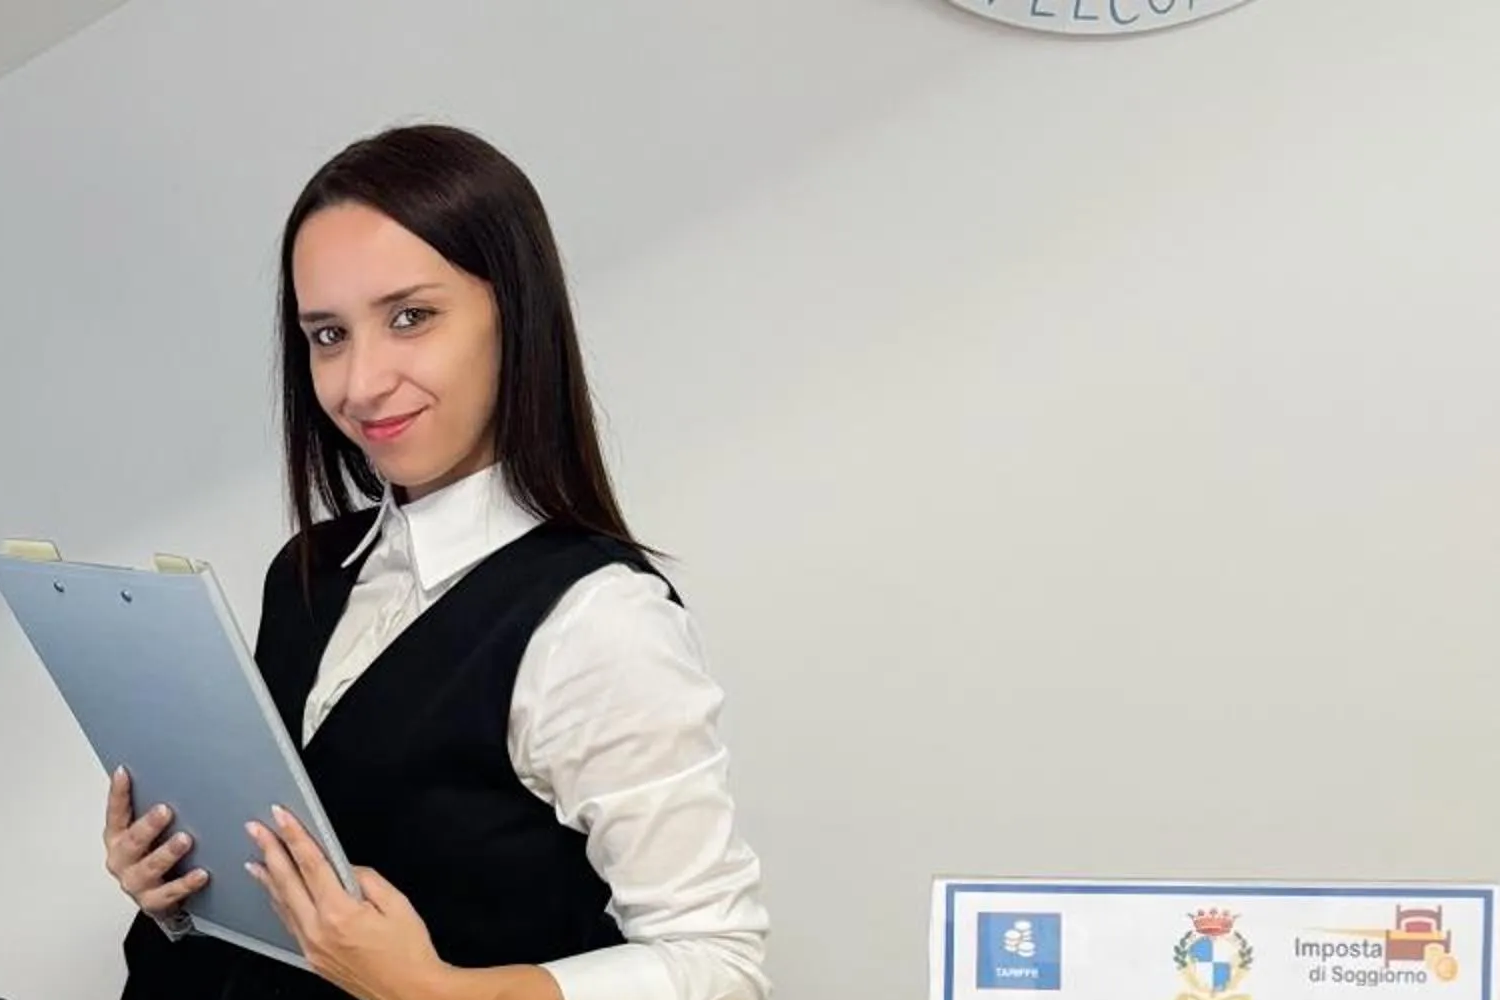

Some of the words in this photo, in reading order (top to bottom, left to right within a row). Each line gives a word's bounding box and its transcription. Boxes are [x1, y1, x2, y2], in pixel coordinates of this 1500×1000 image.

[1295, 938, 1383, 960] Imposta
[1309, 965, 1326, 983] di
[1331, 965, 1428, 987] Soggiorno
